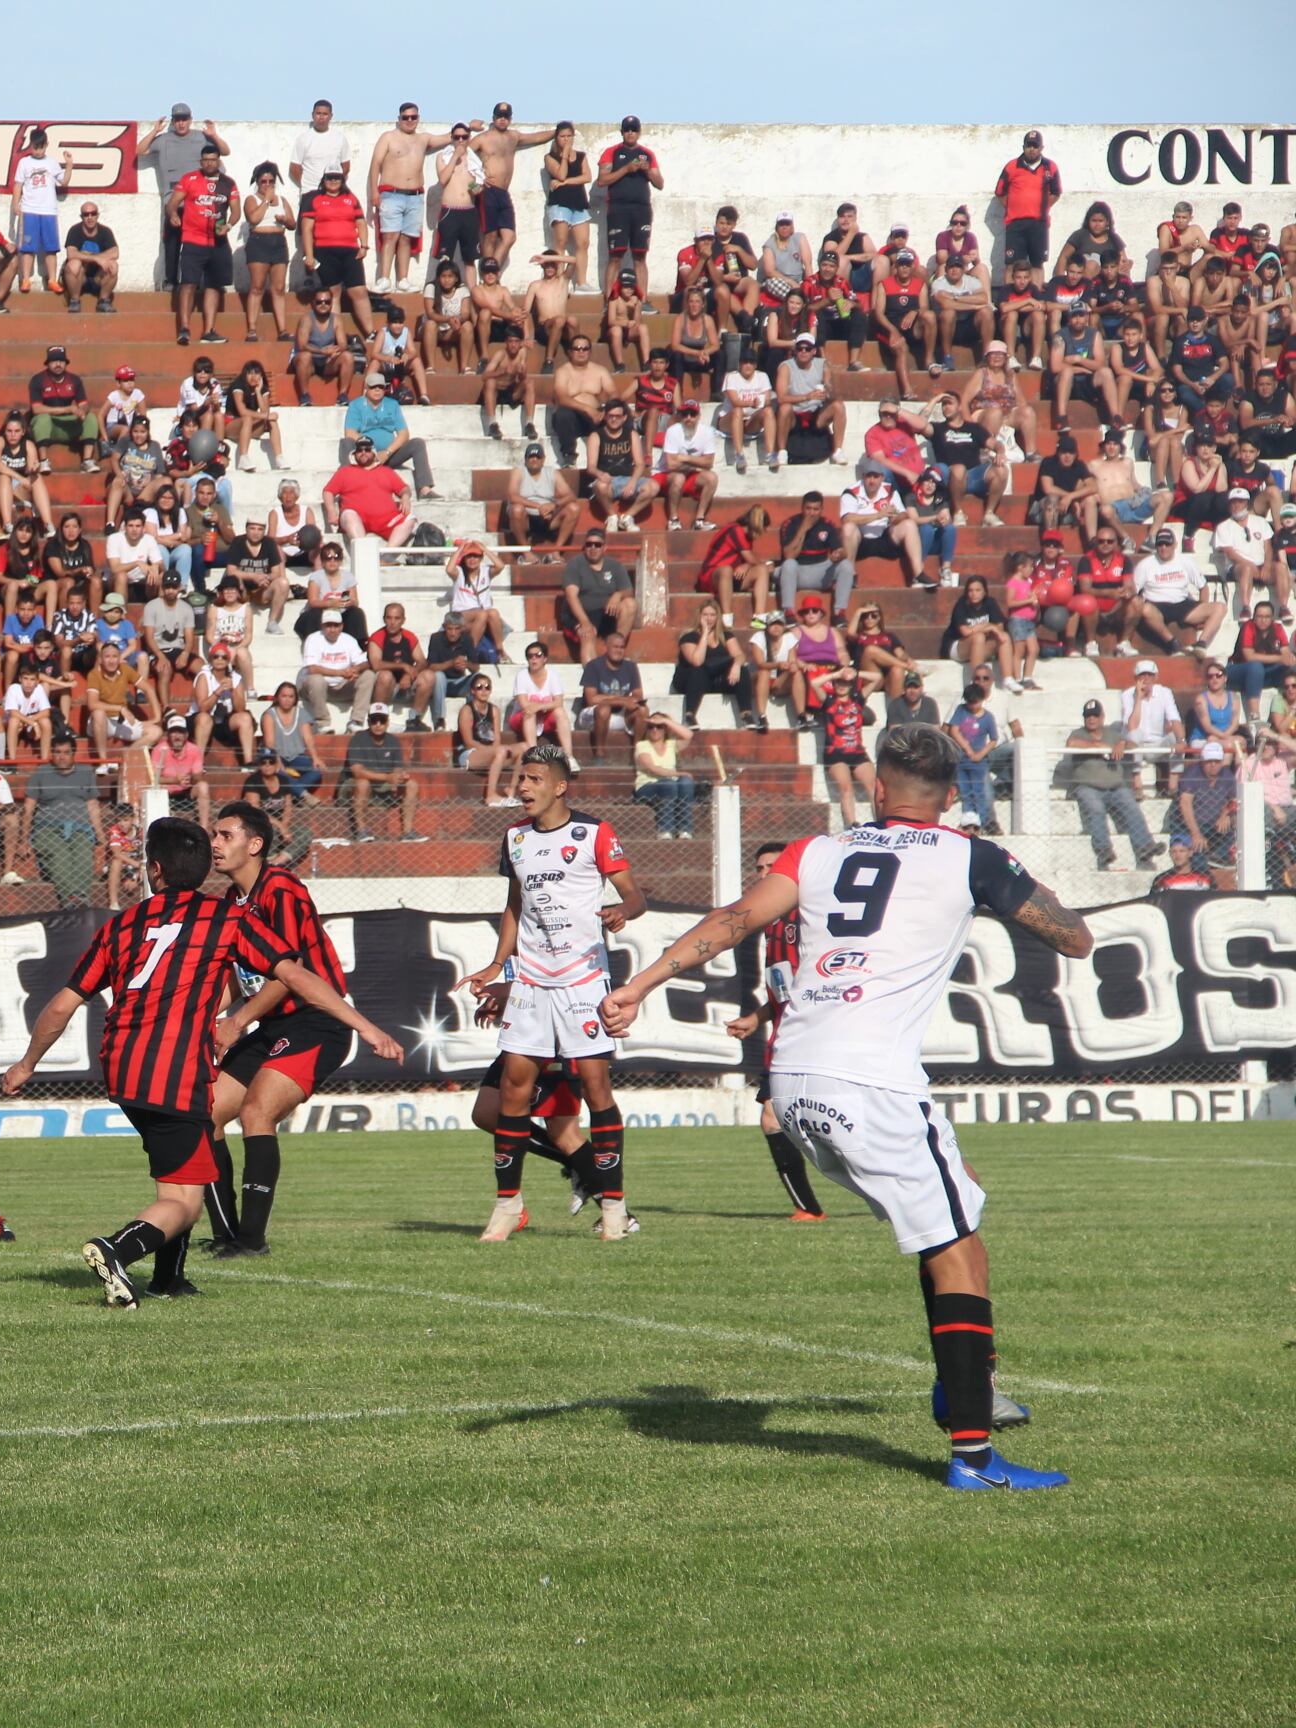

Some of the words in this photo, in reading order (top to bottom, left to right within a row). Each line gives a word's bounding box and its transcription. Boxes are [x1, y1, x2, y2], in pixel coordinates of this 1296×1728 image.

[895, 830, 940, 847] DESIGN
[526, 870, 566, 883] PESOS
[826, 851, 902, 937] 9
[127, 923, 182, 989] 7
[274, 1104, 372, 1133] UR
